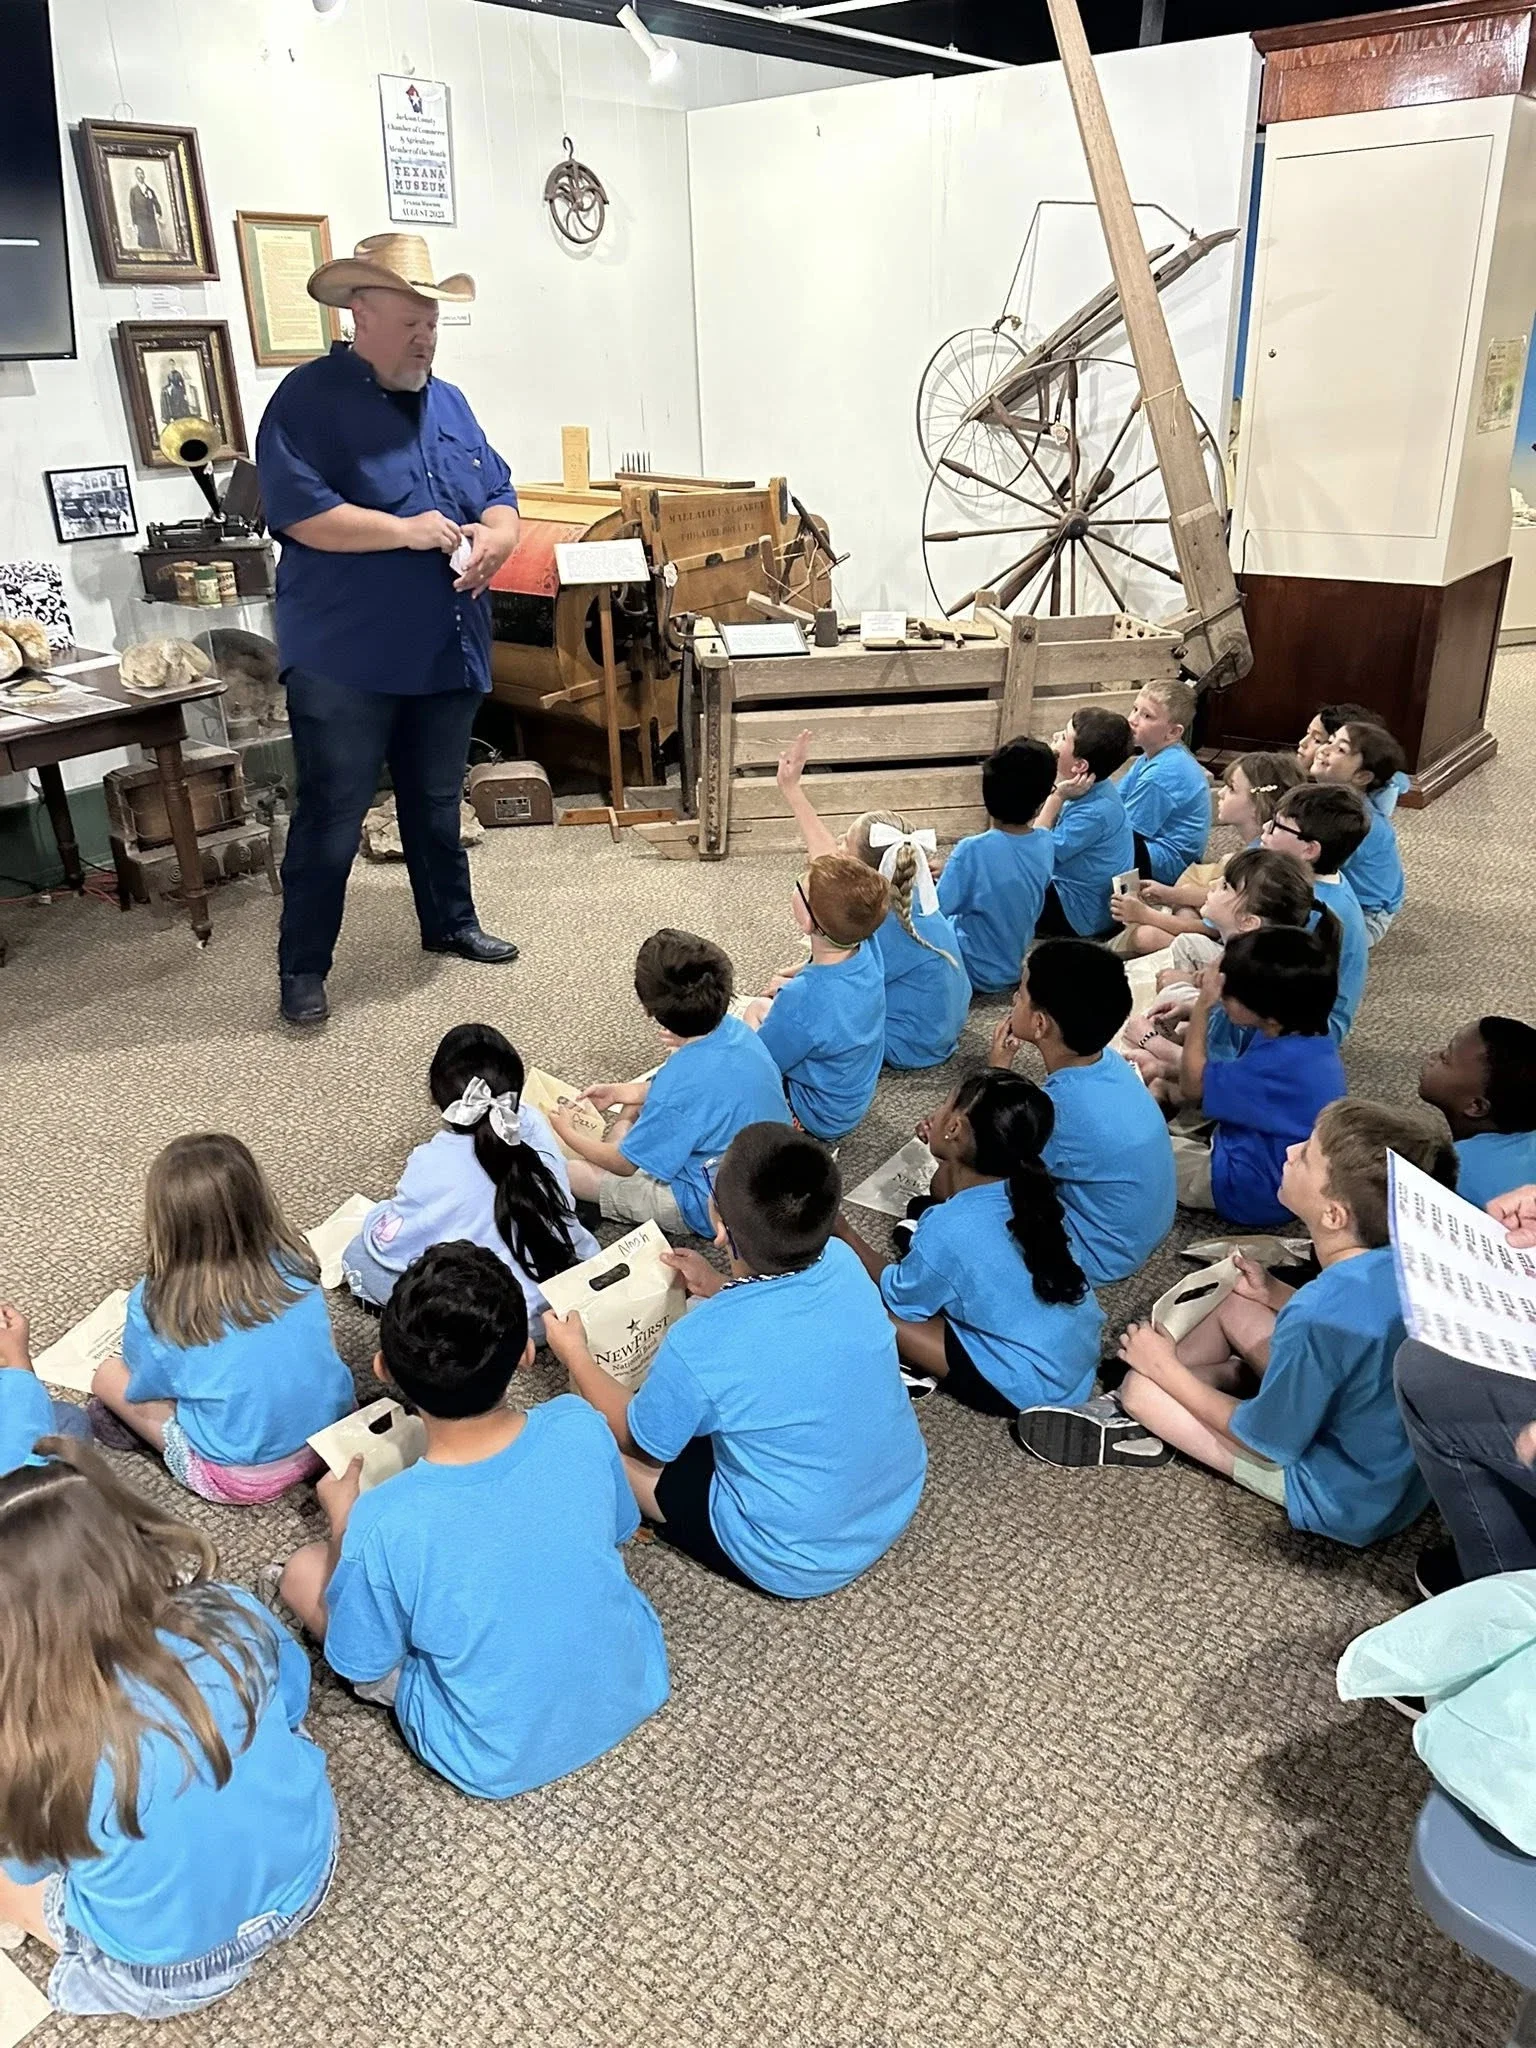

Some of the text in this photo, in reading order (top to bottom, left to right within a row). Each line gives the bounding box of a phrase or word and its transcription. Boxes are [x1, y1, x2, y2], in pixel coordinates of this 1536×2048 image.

[387, 124, 411, 132] Chamber
[419, 127, 446, 136] Commerce
[406, 136, 435, 145] Agriculture
[389, 145, 412, 154] Member
[429, 149, 446, 157] Month
[394, 166, 446, 179] TEXANA
[394, 179, 446, 193] MUSEUM
[402, 208, 428, 217] AUGUST
[595, 1314, 670, 1365] NEWFIRST
[612, 1348, 643, 1371] National
